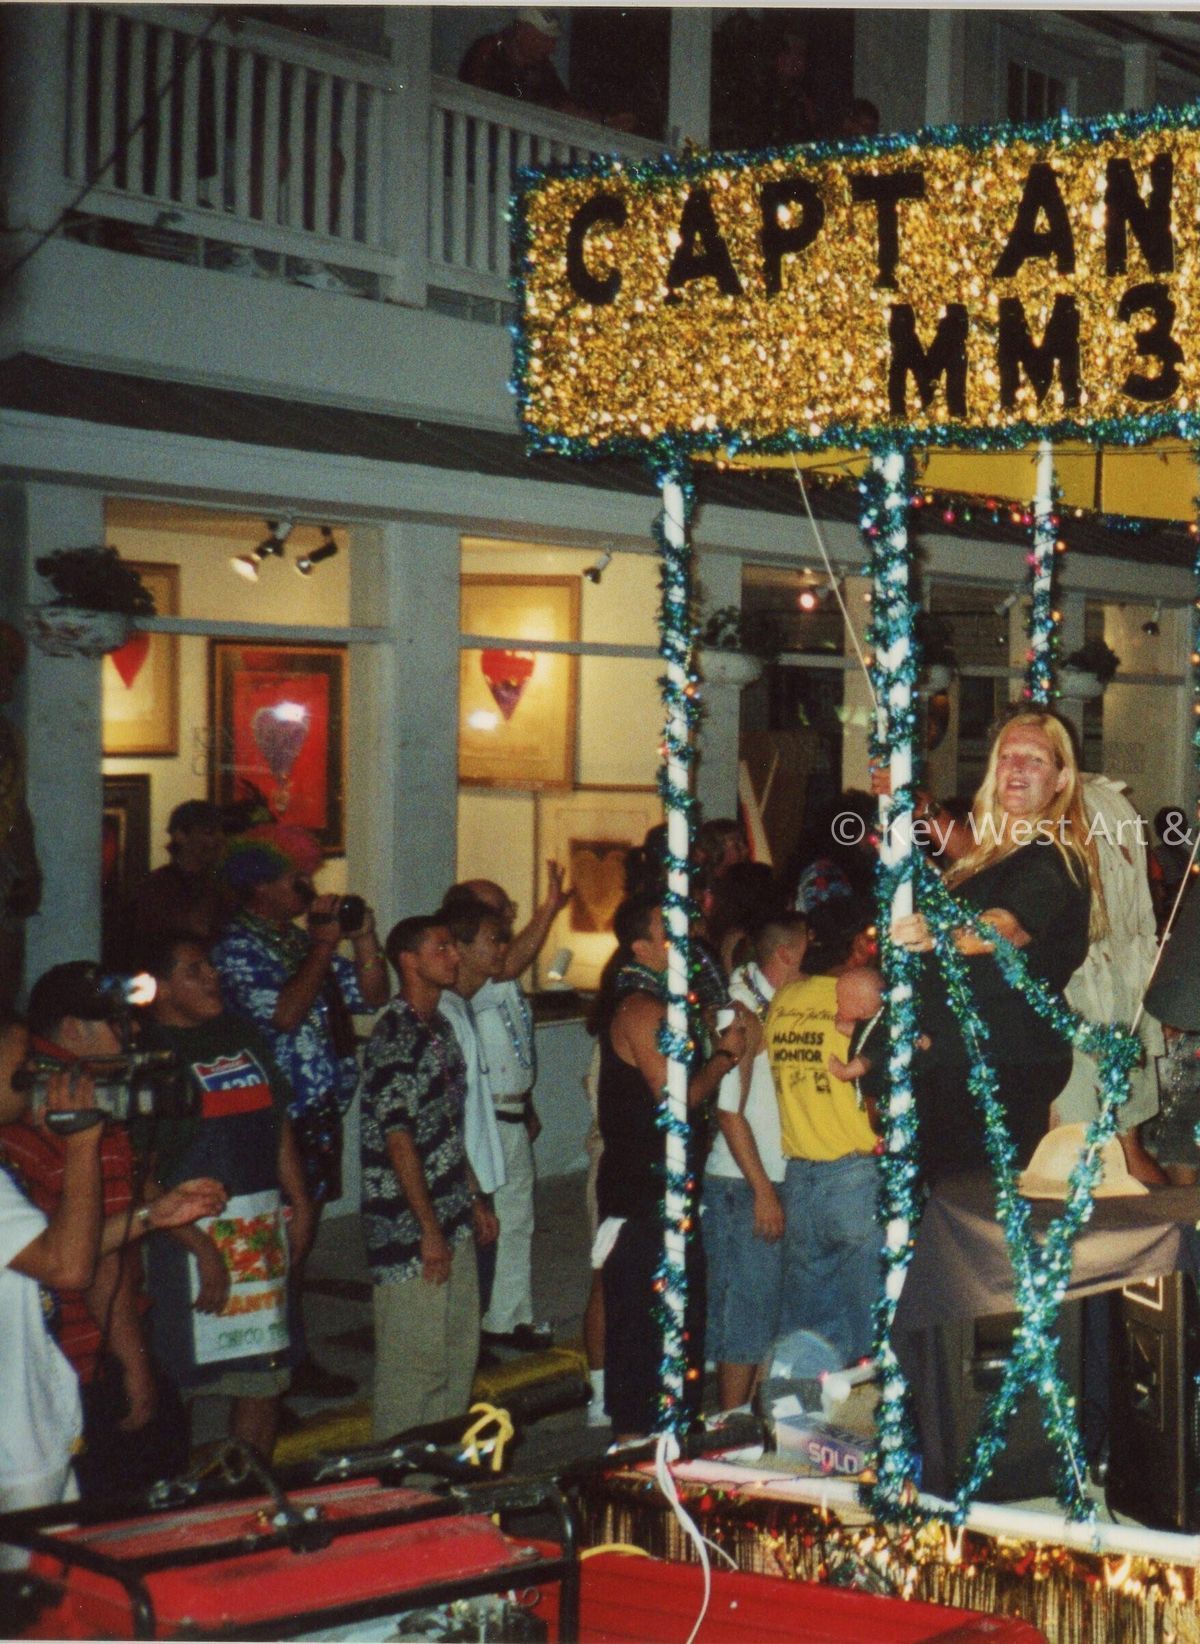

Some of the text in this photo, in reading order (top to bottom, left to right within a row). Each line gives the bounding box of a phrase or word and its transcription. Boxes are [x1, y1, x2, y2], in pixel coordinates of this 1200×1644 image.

[566, 170, 926, 306] CAPT
[773, 1031, 824, 1045] MADNESS
[774, 1049, 823, 1062] MONITOR
[808, 1441, 858, 1475] SOLO
